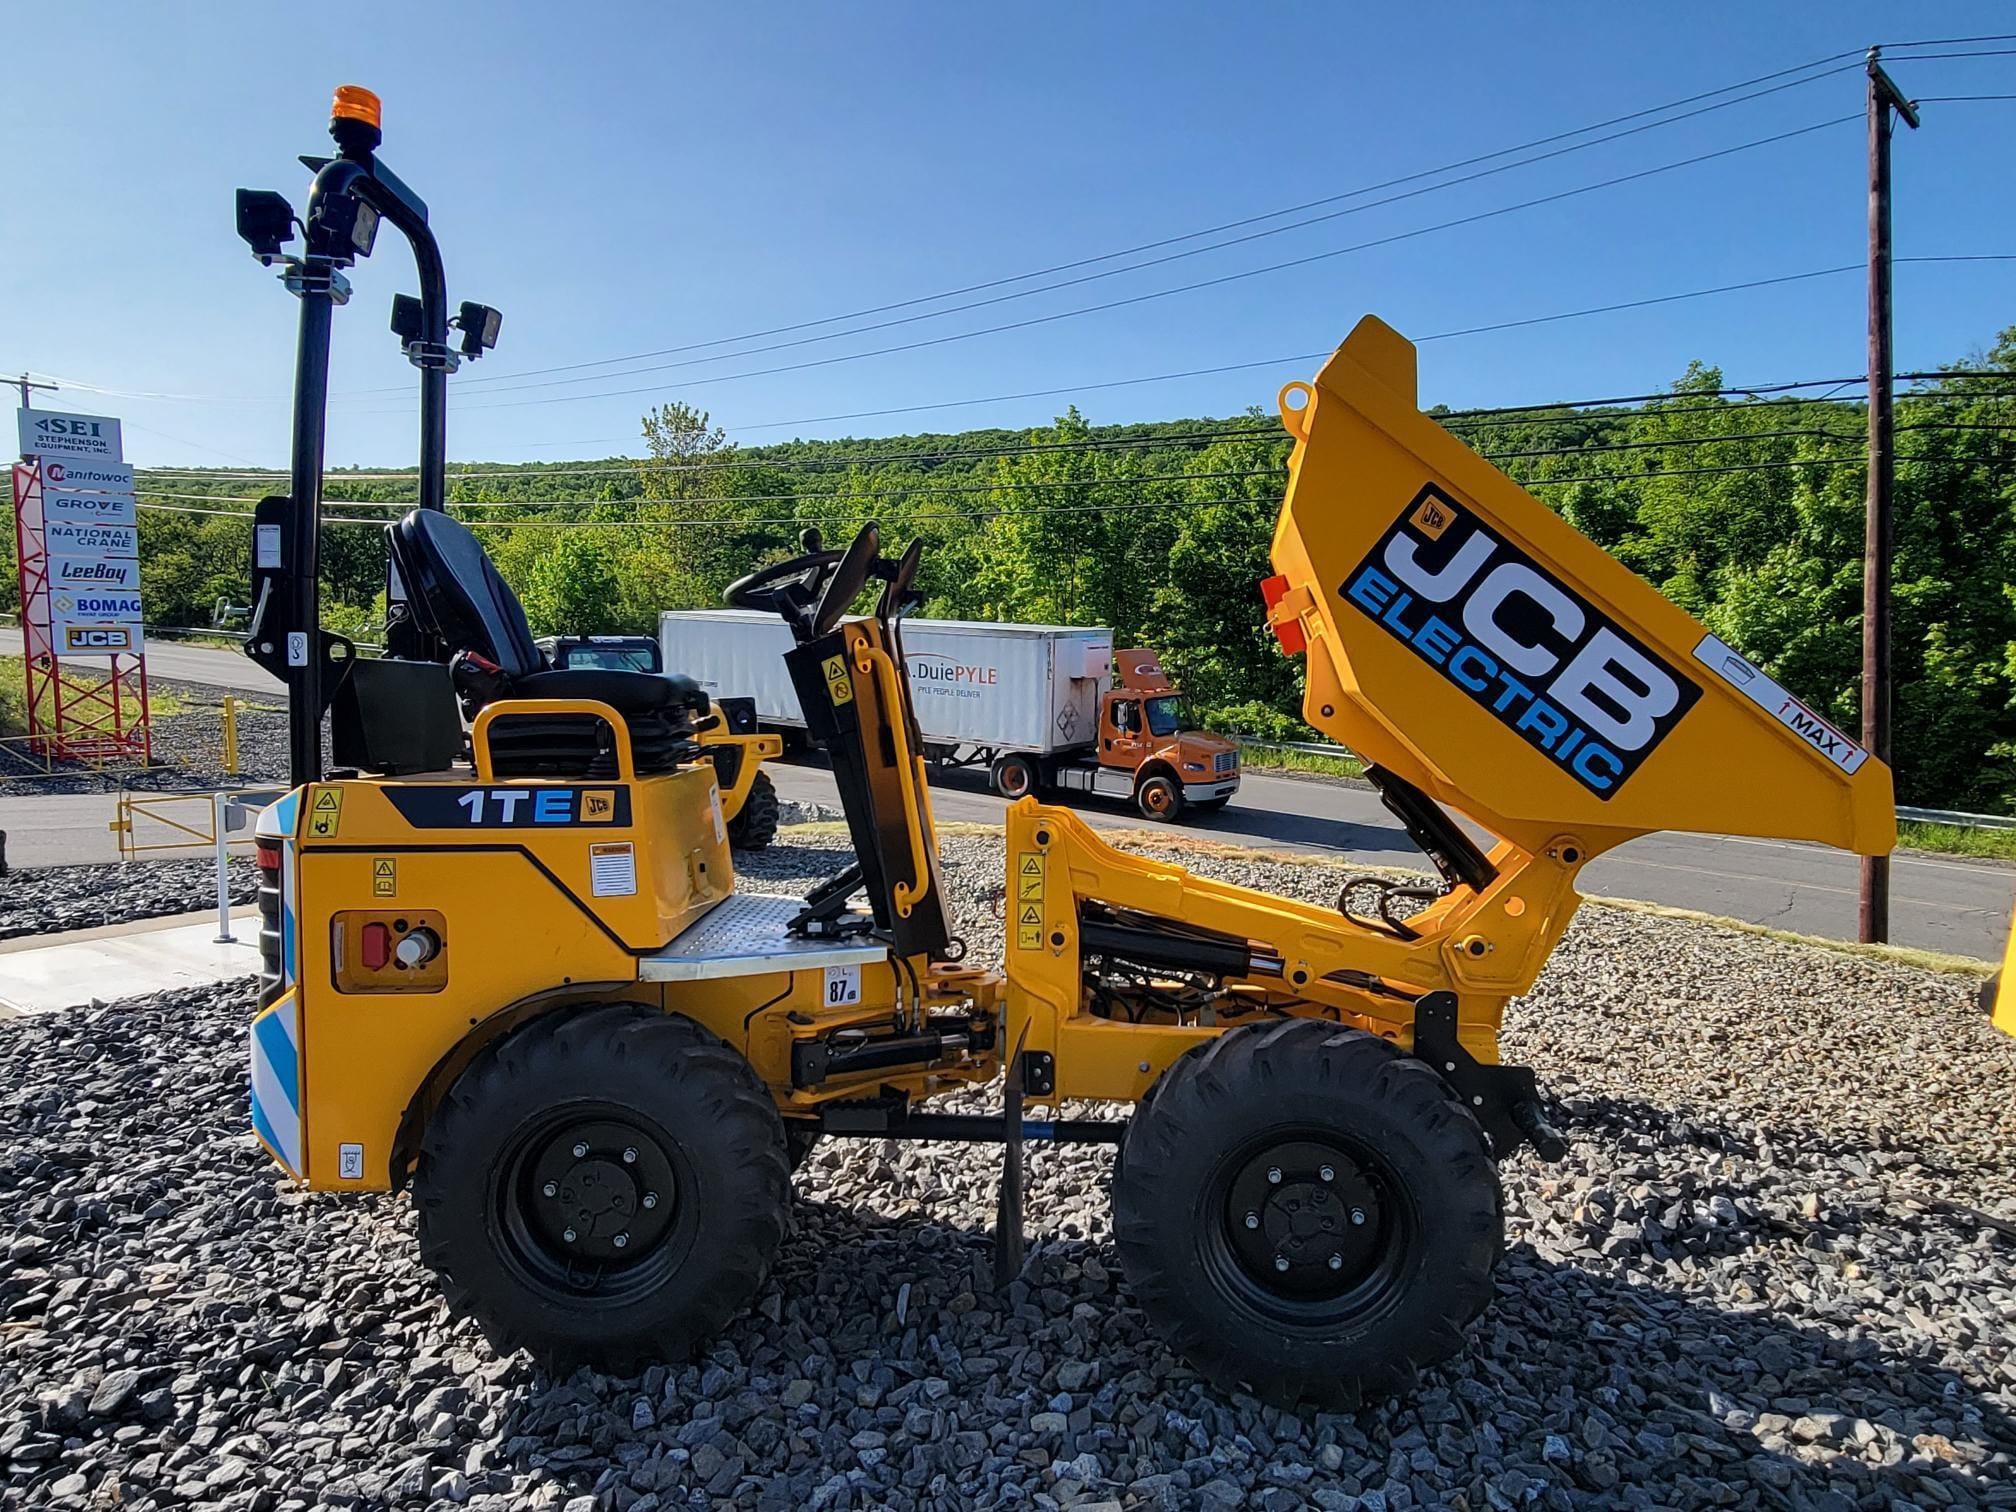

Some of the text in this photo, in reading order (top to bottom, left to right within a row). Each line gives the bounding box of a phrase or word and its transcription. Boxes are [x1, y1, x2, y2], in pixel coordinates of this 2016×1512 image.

[51, 418, 101, 437] SEI
[34, 441, 112, 455] EQUIPMENT, INC.
[37, 434, 107, 447] STEPHENSON
[55, 498, 125, 512] GROVE
[1422, 505, 1445, 529] JCB
[51, 527, 133, 540] NATIONAL
[77, 537, 131, 548] CRANE
[61, 562, 127, 584] LeeBoy
[77, 599, 141, 612] BOMAG
[71, 631, 127, 646] JCB
[1383, 529, 1680, 752] JCB
[1347, 565, 1624, 791] ELECTRIC
[1789, 711, 1843, 756] MAX
[457, 790, 575, 823] 1TE
[588, 798, 609, 814] JCB
[829, 980, 848, 1002] 87
